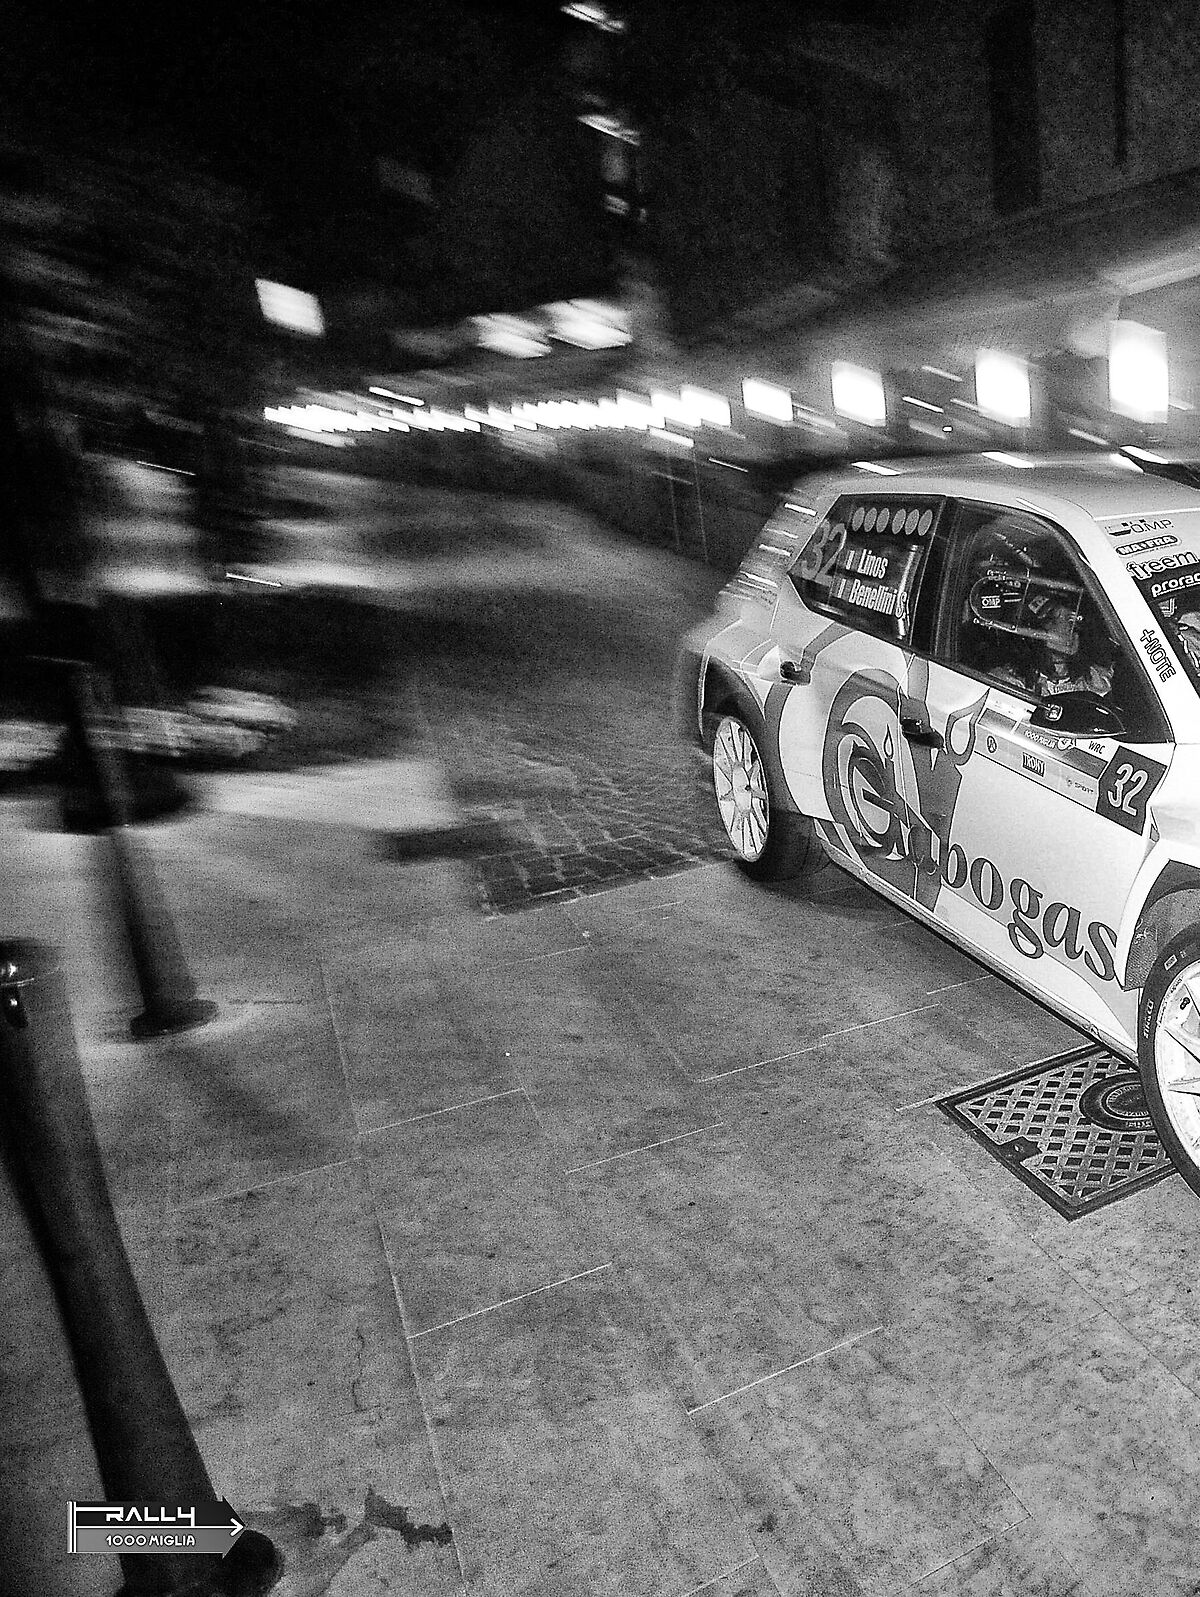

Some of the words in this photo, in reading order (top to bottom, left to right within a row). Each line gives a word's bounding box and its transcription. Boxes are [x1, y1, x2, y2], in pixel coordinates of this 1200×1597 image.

[802, 519, 847, 588] 32
[857, 549, 888, 579] Linos
[1126, 551, 1199, 580] freem
[848, 578, 898, 615] Benellini
[1087, 739, 1106, 755] WRC
[1107, 763, 1149, 816] 32
